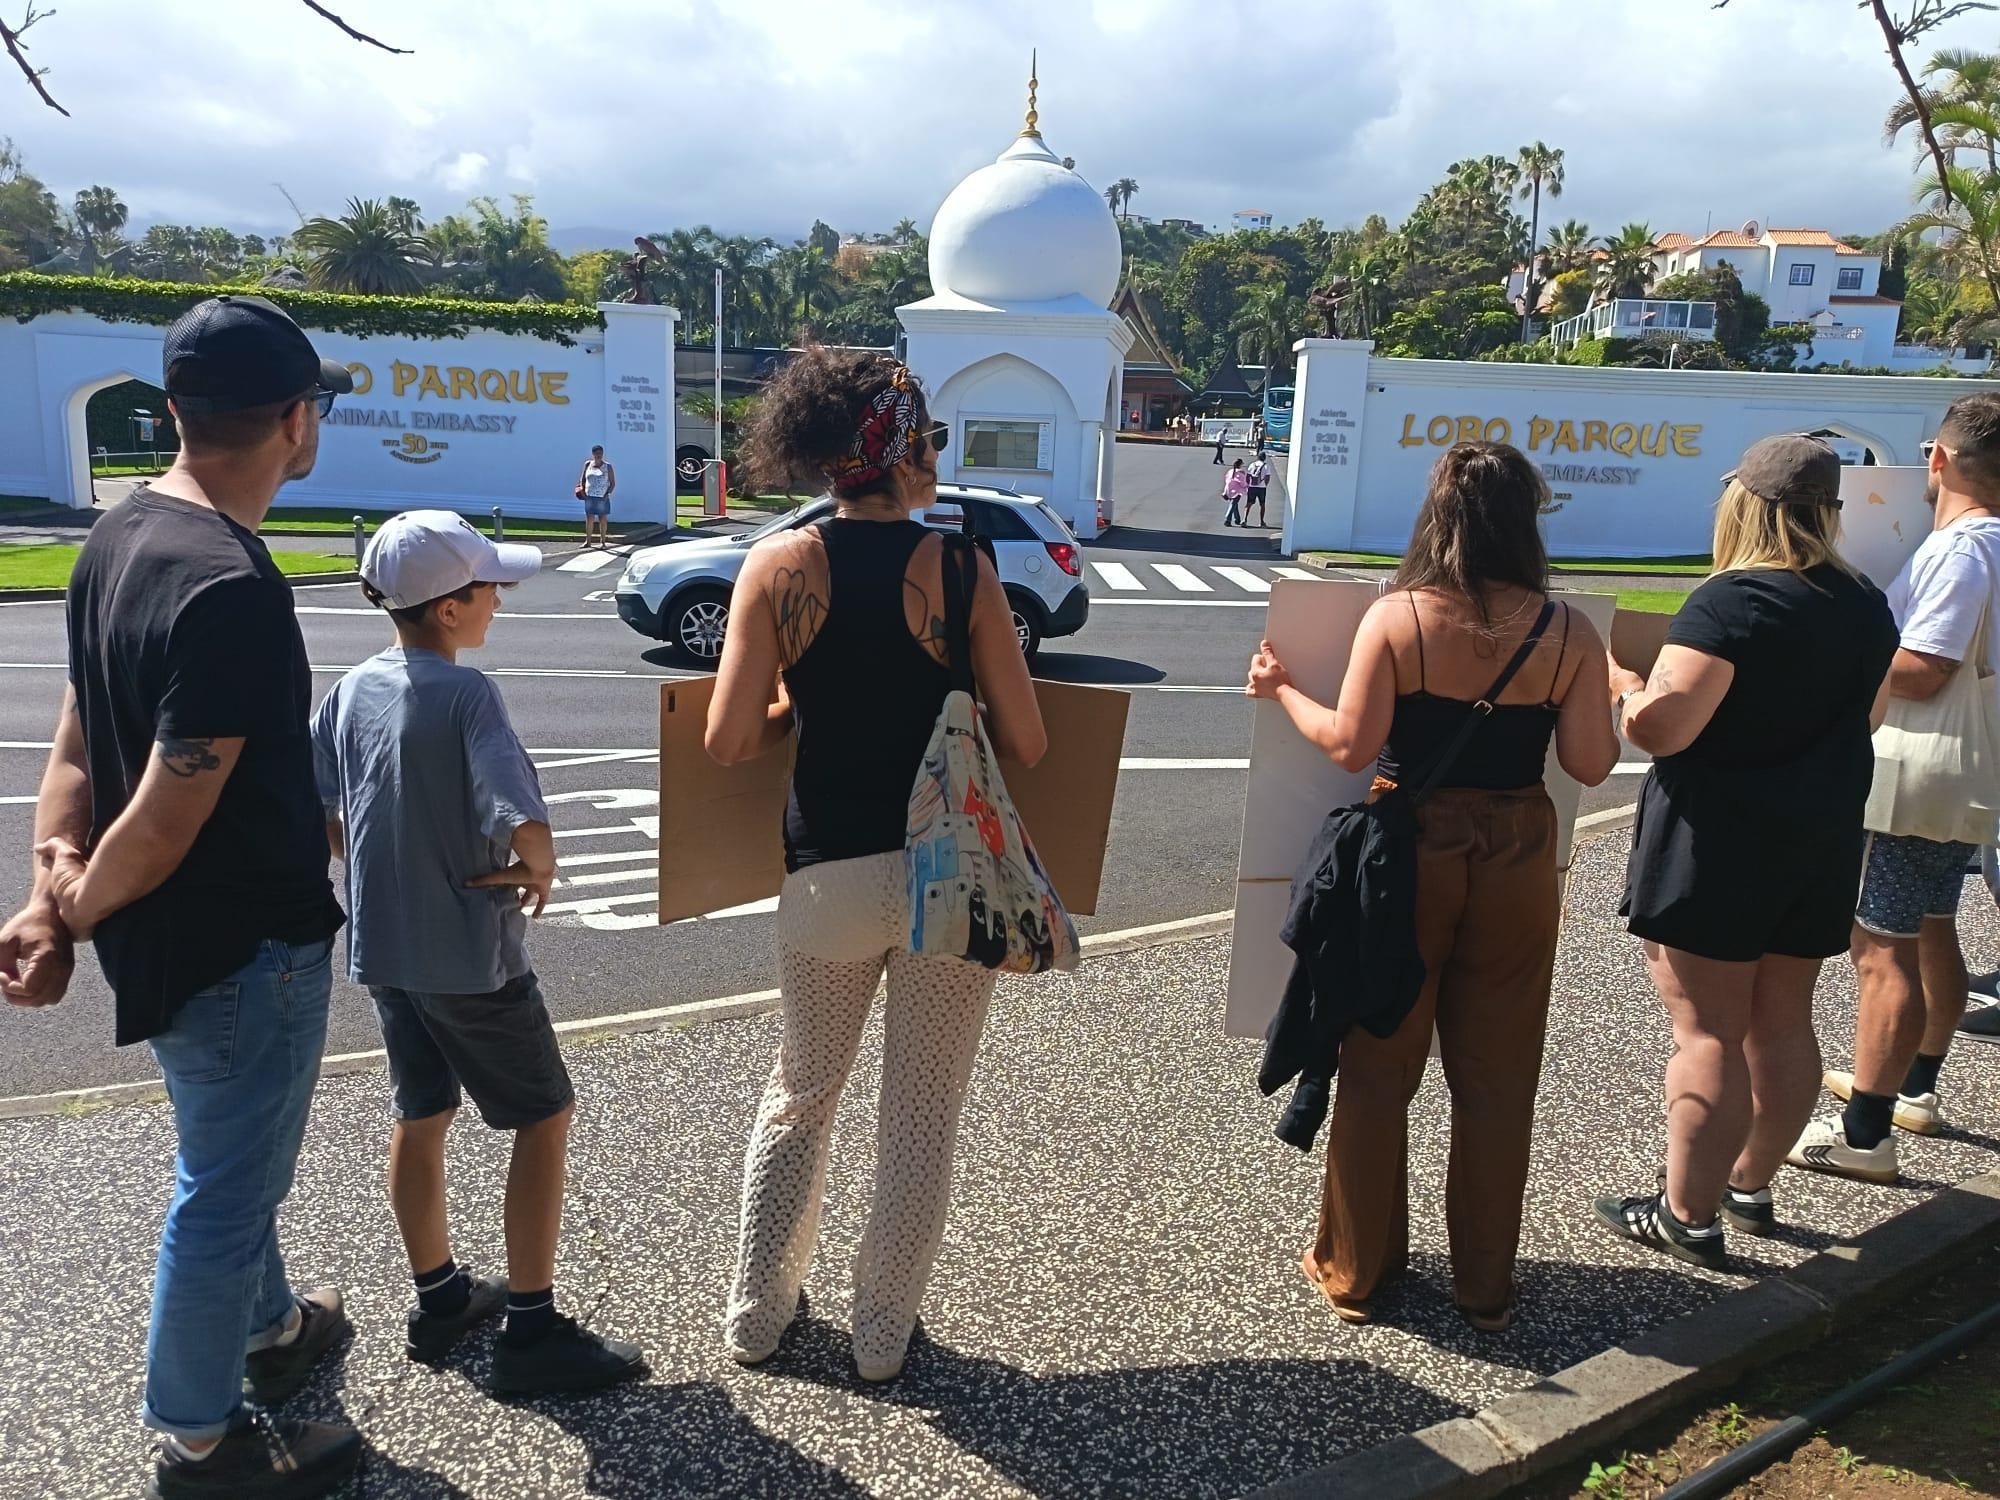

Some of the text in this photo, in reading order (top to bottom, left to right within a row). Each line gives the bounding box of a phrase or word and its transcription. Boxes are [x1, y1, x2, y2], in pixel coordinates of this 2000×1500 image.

[390, 358, 570, 405] PARQUE
[644, 400, 651, 411] h
[411, 411, 517, 434] EMBASSY
[617, 421, 655, 432] 17:30 h
[402, 433, 427, 454] 50
[1339, 433, 1346, 444] h
[1528, 414, 1703, 457] PARQUE
[1312, 454, 1347, 465] 17:30 h
[1542, 464, 1642, 484] EMBASSY
